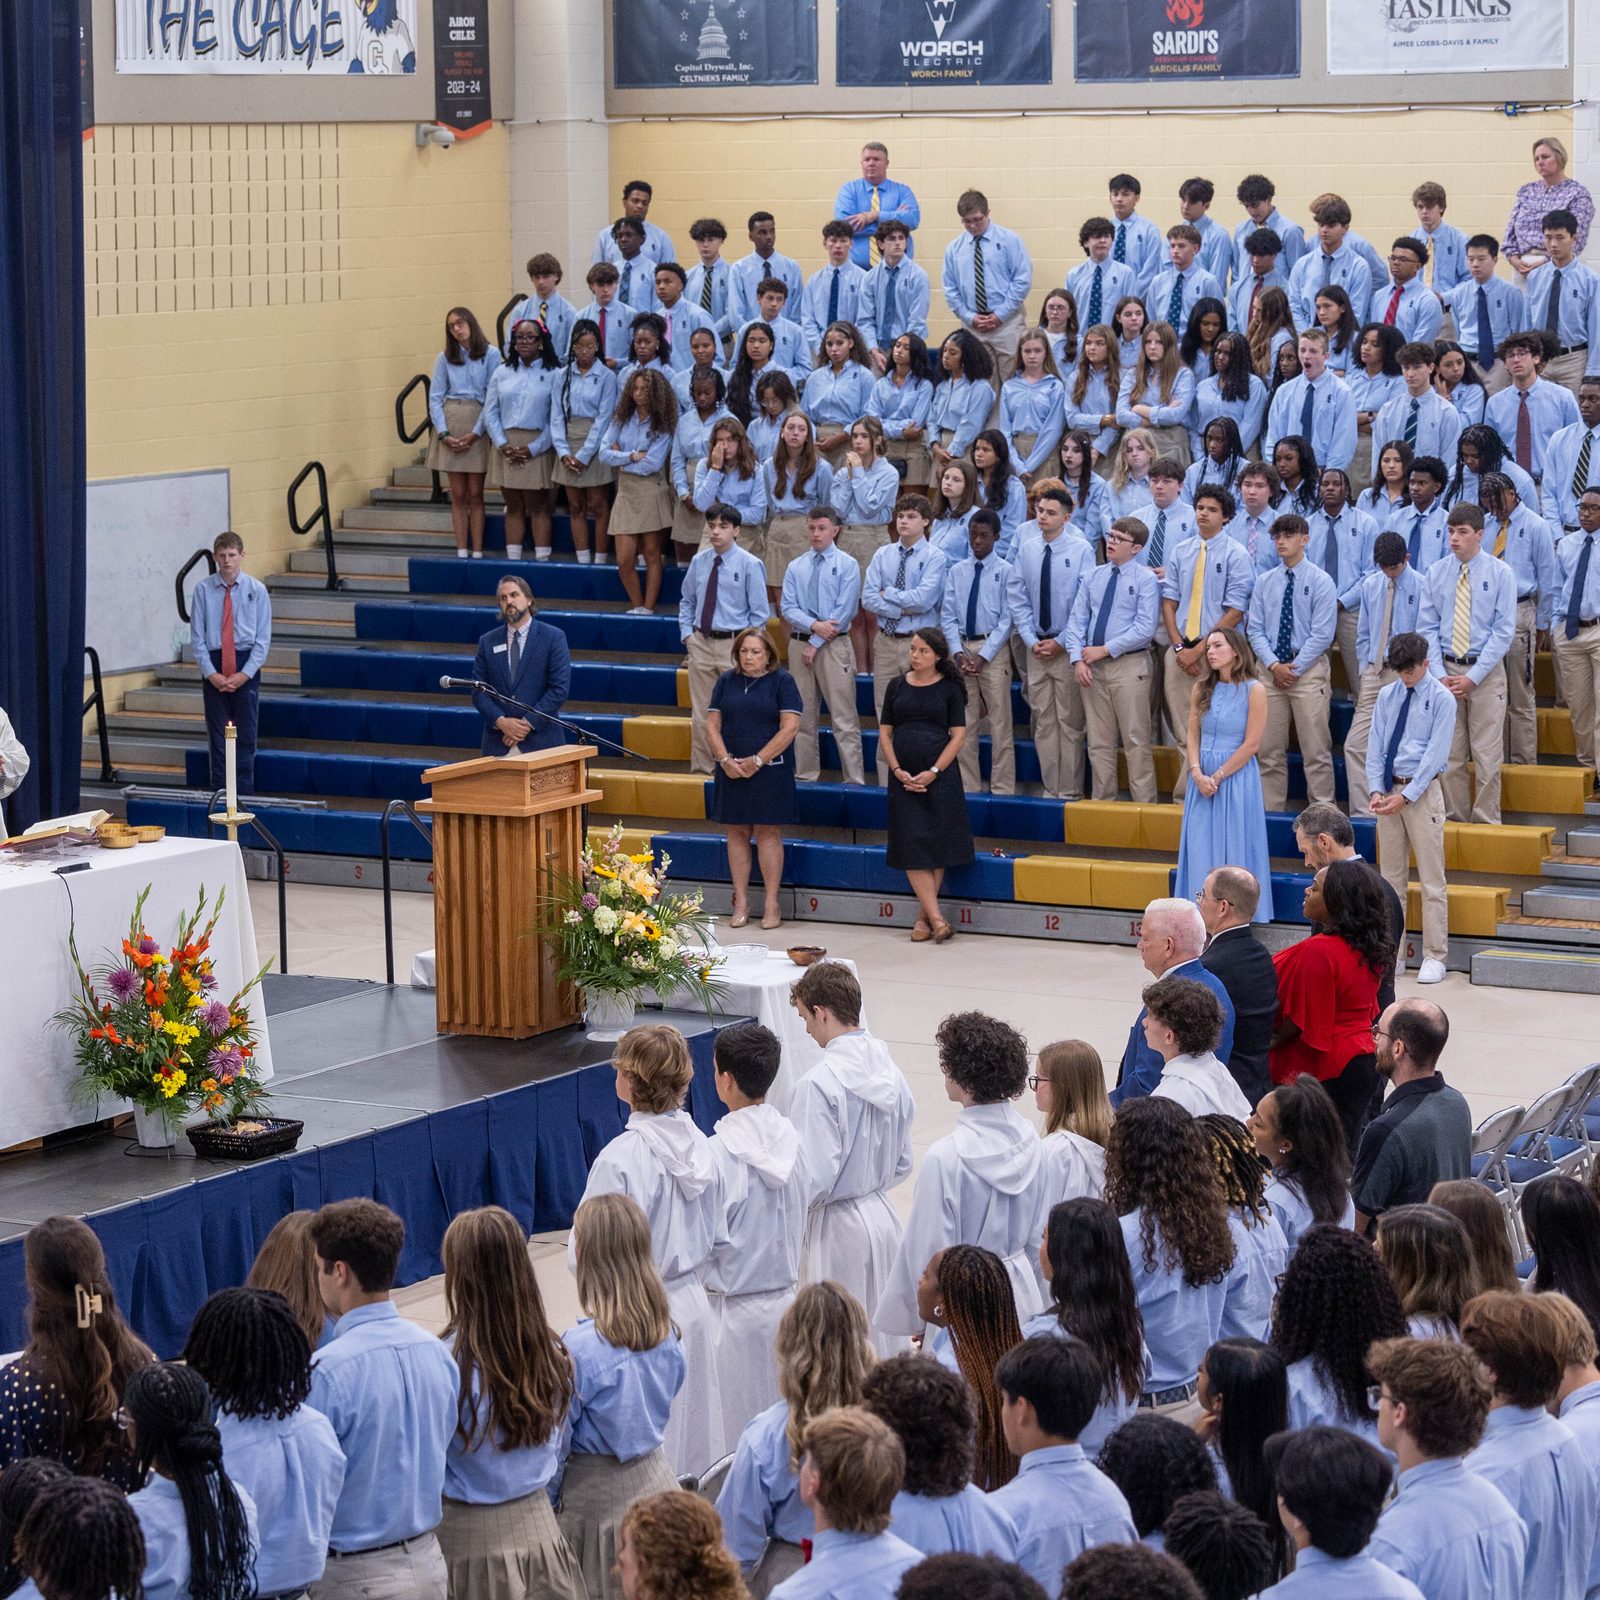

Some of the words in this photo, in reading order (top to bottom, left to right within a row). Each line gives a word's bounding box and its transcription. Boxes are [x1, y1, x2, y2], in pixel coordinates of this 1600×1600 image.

[233, 0, 344, 69] CAGE
[900, 40, 983, 57] WORCH
[1152, 29, 1219, 55] SARDI'S
[674, 63, 702, 73] Capitol
[704, 63, 737, 72] Drywall,
[739, 62, 754, 71] Inc.
[903, 57, 982, 66] ELECTRIC
[1149, 65, 1191, 73] SARDELIS
[1192, 63, 1222, 72] FAMILY
[722, 73, 749, 82] FAMILY
[911, 70, 942, 78] WORCH
[944, 69, 973, 77] FAMILY
[447, 81, 480, 94] 2023-24
[354, 865, 362, 879] 3
[809, 897, 818, 912] 9
[879, 902, 893, 917] 10
[959, 908, 972, 924] 11
[1045, 914, 1060, 931] 12
